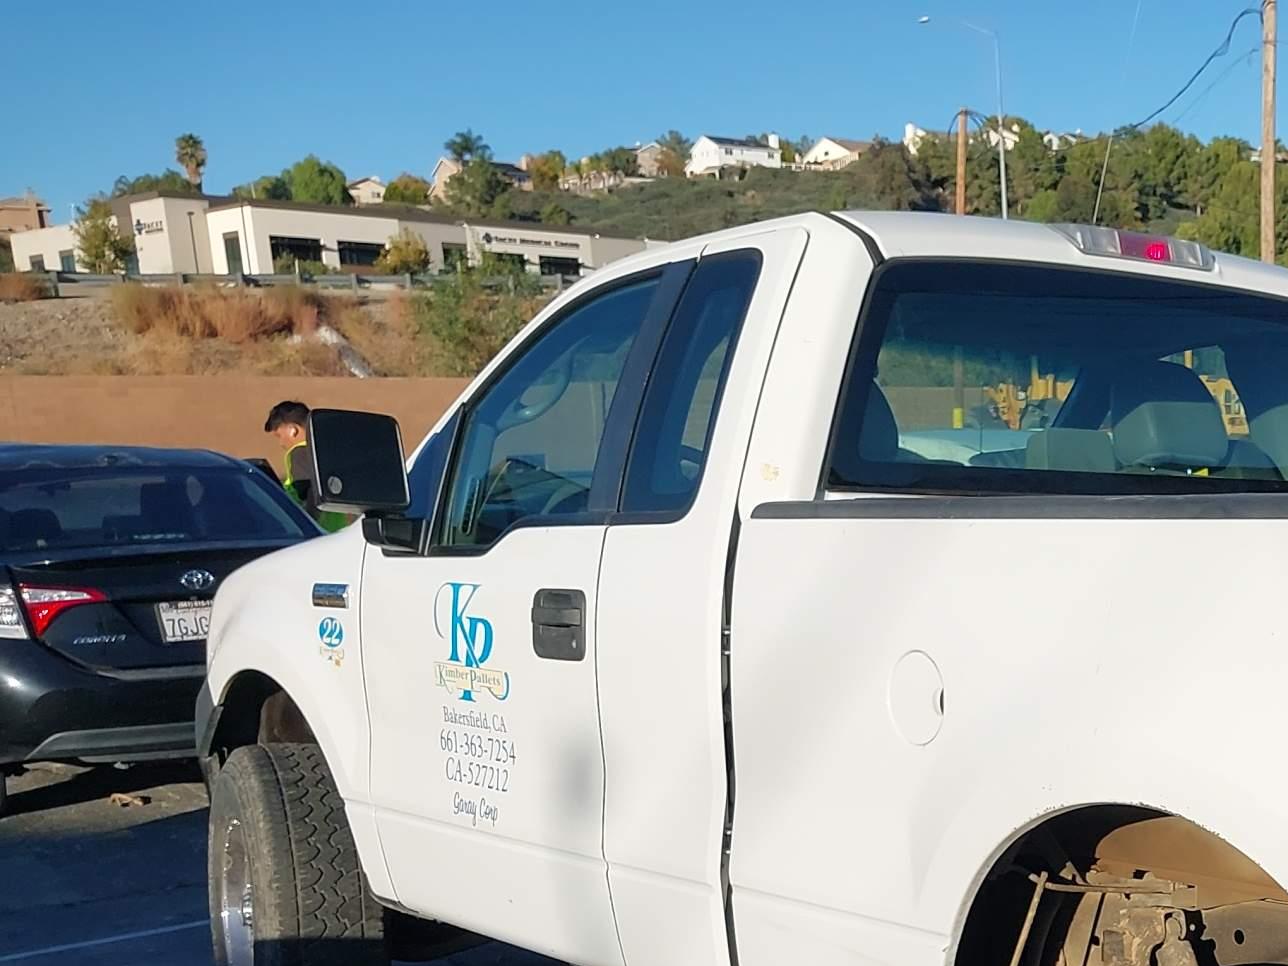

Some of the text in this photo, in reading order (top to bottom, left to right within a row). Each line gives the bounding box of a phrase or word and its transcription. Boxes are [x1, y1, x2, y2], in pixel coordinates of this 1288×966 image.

[323, 618, 341, 645] 22
[442, 705, 507, 733] Bakersfield, CA
[440, 728, 516, 765] 661-363-7254
[446, 756, 509, 792] CA-527212
[453, 791, 498, 827] Garay Corp
